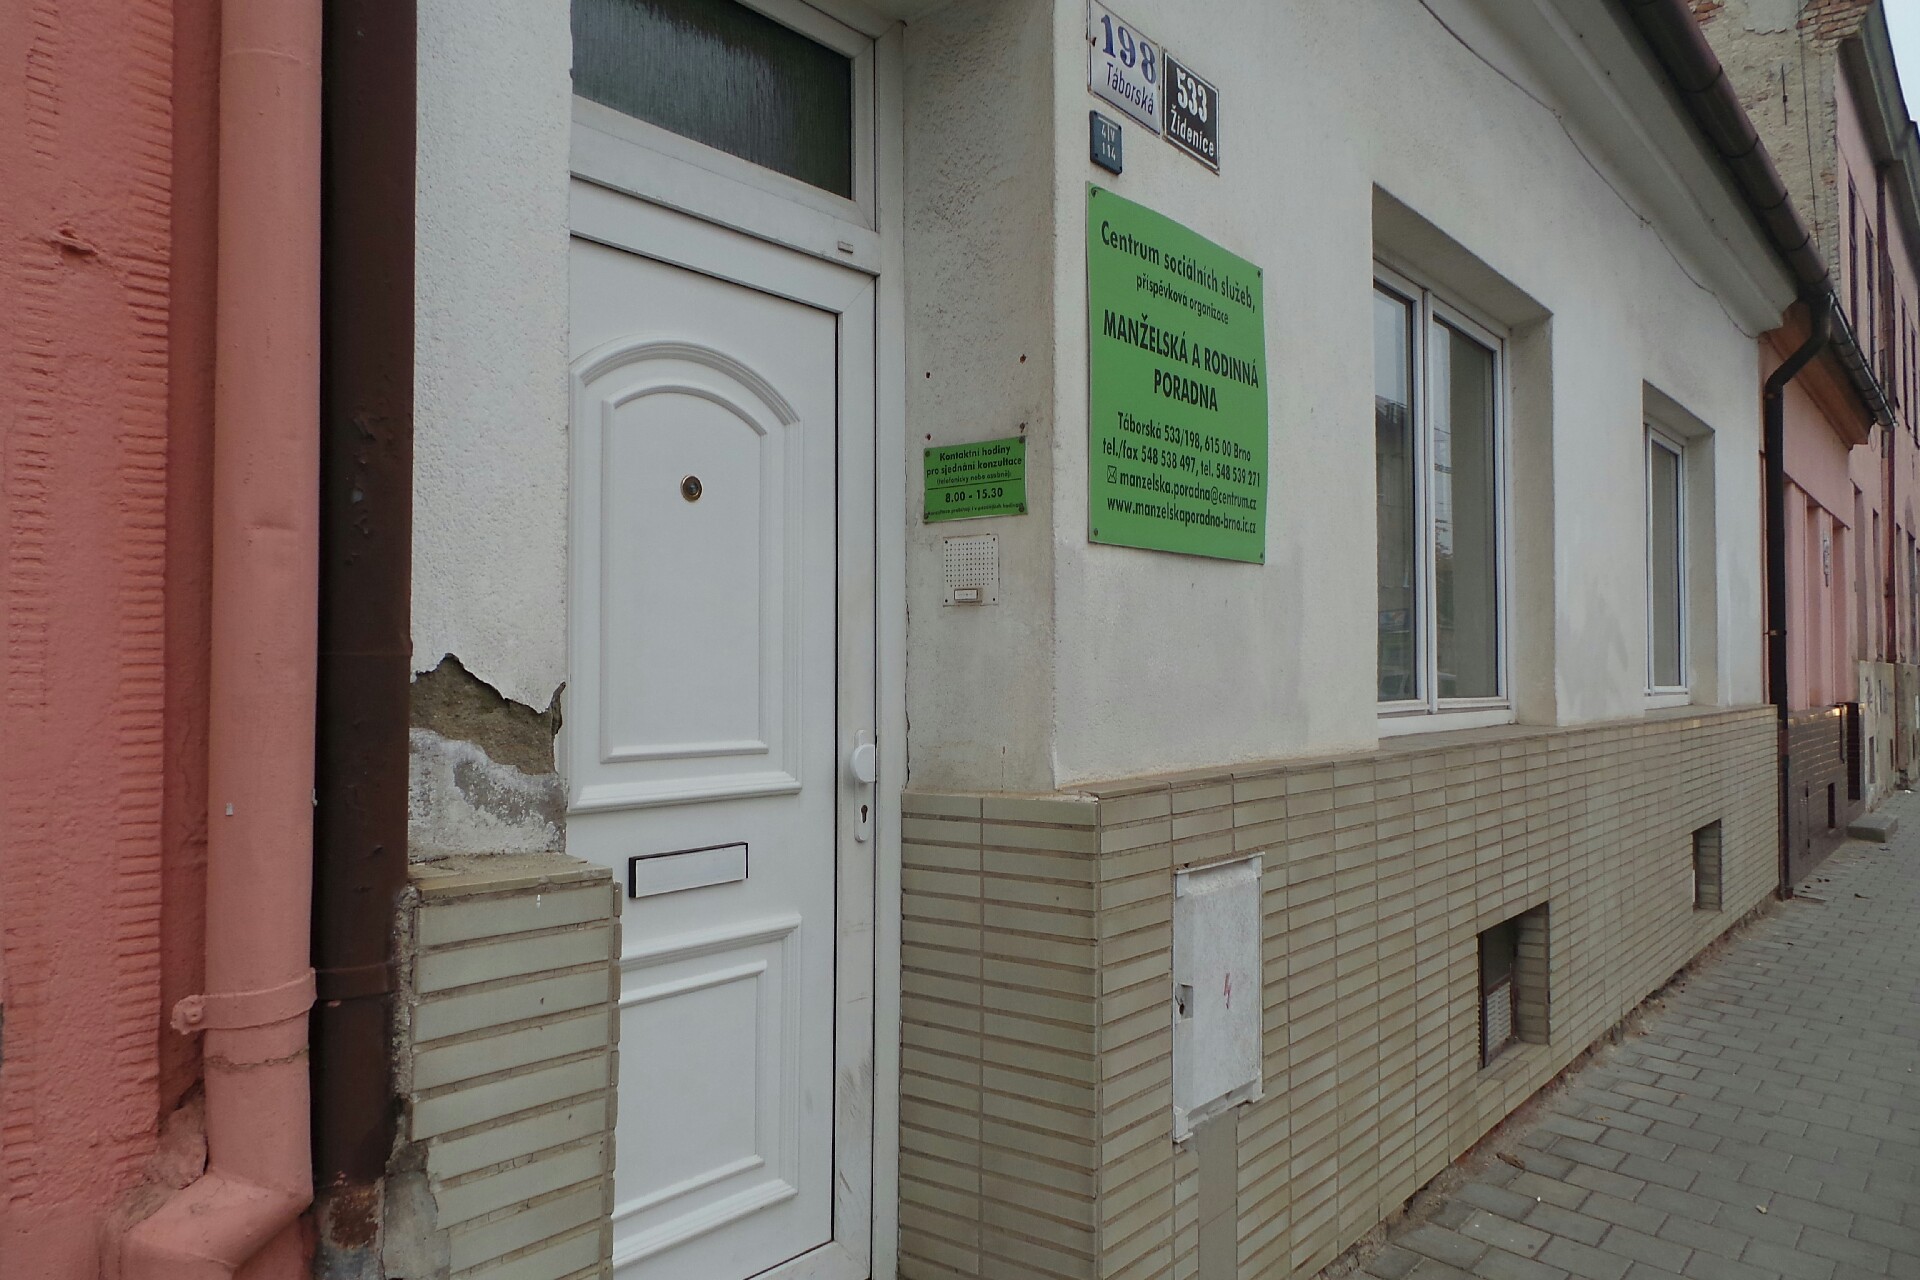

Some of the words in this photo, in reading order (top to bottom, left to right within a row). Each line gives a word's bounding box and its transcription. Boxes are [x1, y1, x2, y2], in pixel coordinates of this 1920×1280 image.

[1101, 14, 1156, 84] 198
[1107, 62, 1154, 115] Táborská
[1176, 67, 1207, 123] 533
[1170, 104, 1214, 157] Židenice
[1101, 220, 1160, 266] Centrum
[1164, 254, 1218, 292] sociálních
[1221, 276, 1256, 314] služeb,
[1136, 273, 1188, 307] příspěvková
[1189, 297, 1229, 325] organizace
[1103, 309, 1188, 364] MANŽELSKÁ
[1192, 343, 1201, 369] A
[1204, 347, 1259, 388] RODINNÁ
[1154, 368, 1218, 412] PORADNA
[940, 448, 980, 461] Kontaktní
[982, 445, 1011, 455] hodiny
[1118, 411, 1162, 440] Táborská
[1164, 424, 1203, 452] 533/198,
[1204, 435, 1220, 454] 615
[1222, 439, 1232, 457] 00
[1233, 442, 1251, 462] Brno
[926, 468, 939, 478] pro
[941, 462, 975, 475] sjednání
[977, 457, 1022, 469] konzultace
[1103, 437, 1138, 460] tel./fax
[1141, 445, 1158, 465] 548
[1161, 450, 1177, 469] 538
[1180, 454, 1199, 477] 497,
[1200, 460, 1214, 477] tel.
[1216, 462, 1231, 480] 548
[1232, 466, 1246, 484] 539
[1247, 470, 1260, 488] 271
[945, 491, 965, 503] 8.00
[977, 487, 1003, 499] 15.30
[1107, 497, 1256, 534] www.manzelskaporadna-brno.ic.cz
[1120, 472, 1257, 510] manzelska.poradna@centrum.cz
